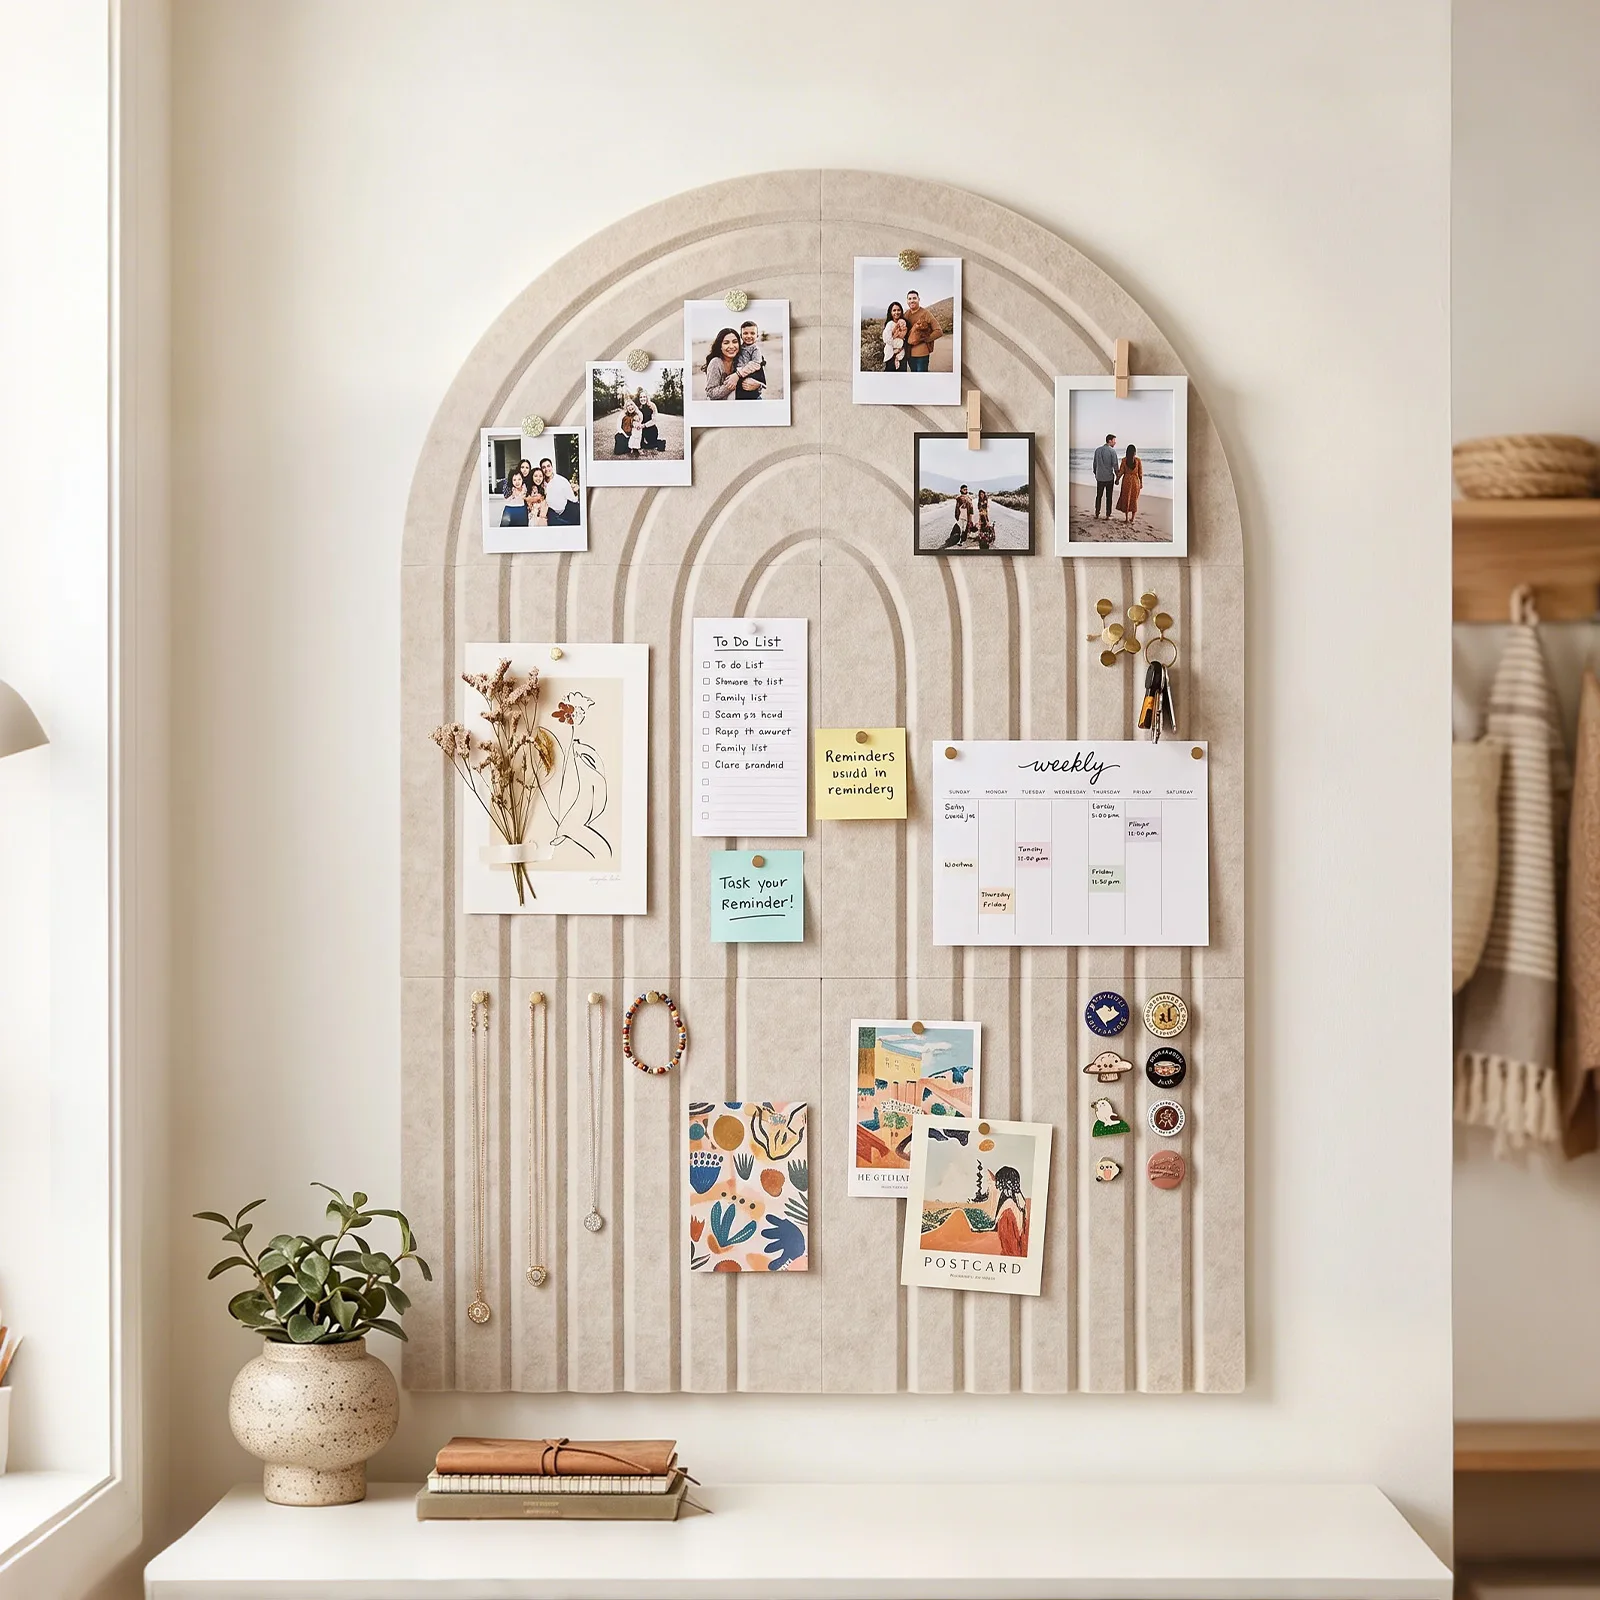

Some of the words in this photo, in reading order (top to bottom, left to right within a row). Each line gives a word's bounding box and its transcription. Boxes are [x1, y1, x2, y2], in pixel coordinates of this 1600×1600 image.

[713, 636, 728, 647] To
[734, 636, 749, 647] Do
[755, 636, 781, 647] List
[715, 660, 726, 669] To
[730, 660, 742, 669] do
[745, 660, 764, 669] List
[715, 693, 746, 705] Family
[751, 693, 768, 702] list
[715, 743, 747, 755] Family
[751, 744, 768, 752] list
[825, 749, 896, 763] Reminders
[874, 767, 887, 778] in
[1018, 751, 1121, 785] weekly
[719, 876, 751, 889] Task
[757, 878, 788, 893] your
[721, 894, 794, 910] Reminder!
[983, 902, 1007, 911] Friday
[923, 1256, 1022, 1275] POSTCARD
